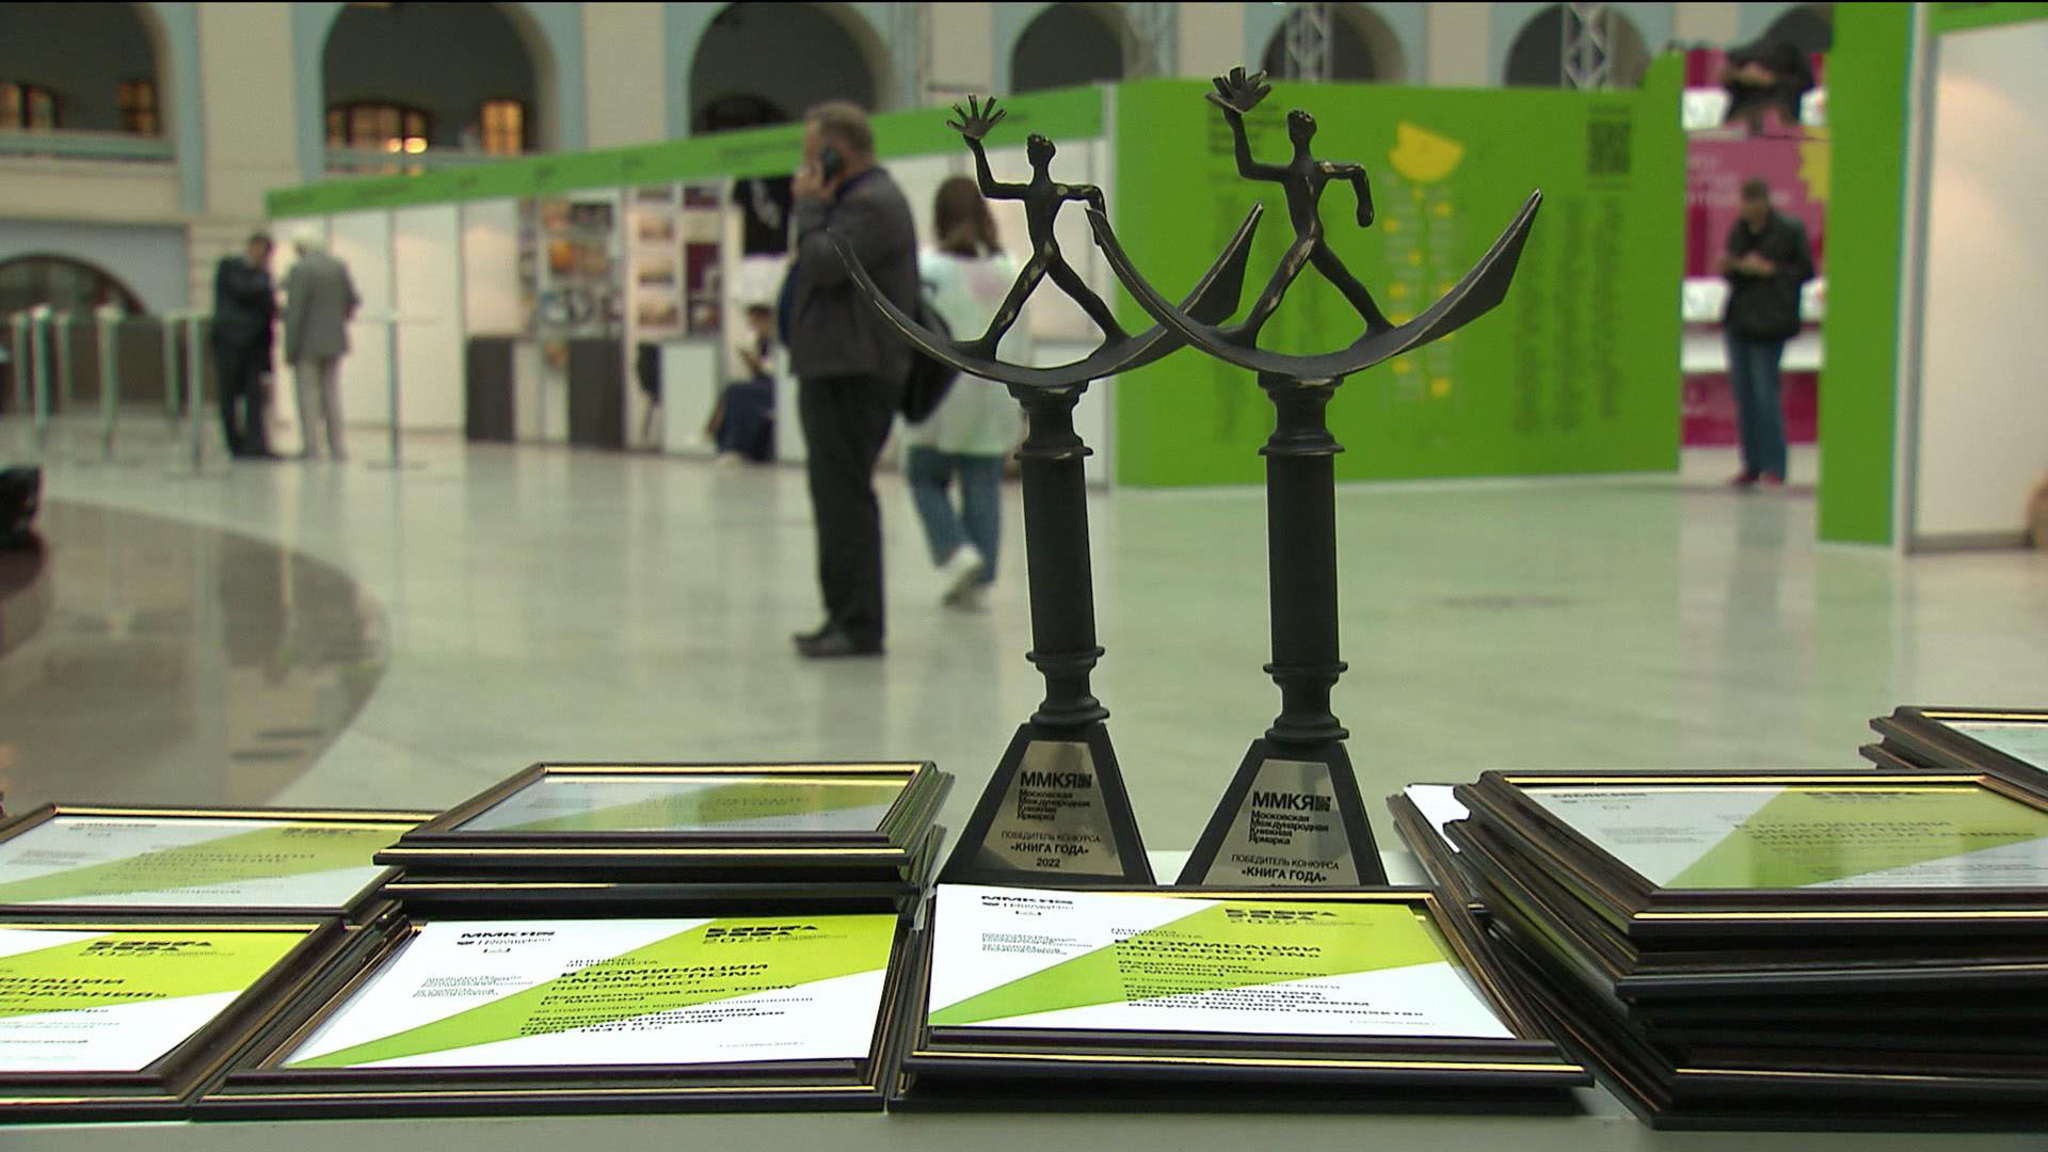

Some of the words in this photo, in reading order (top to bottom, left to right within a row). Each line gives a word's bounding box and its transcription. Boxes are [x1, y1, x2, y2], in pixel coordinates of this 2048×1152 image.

[1020, 771, 1076, 788] ММКЯ
[1252, 791, 1314, 811] ММКЯ
[1251, 810, 1310, 822] Московская
[1036, 857, 1061, 868] 2022
[1231, 854, 1290, 867] ПОБЕДИТЕЛЬ
[1291, 859, 1339, 870] КОНКУРСА
[584, 963, 769, 977] НОМИНАЦИИ
